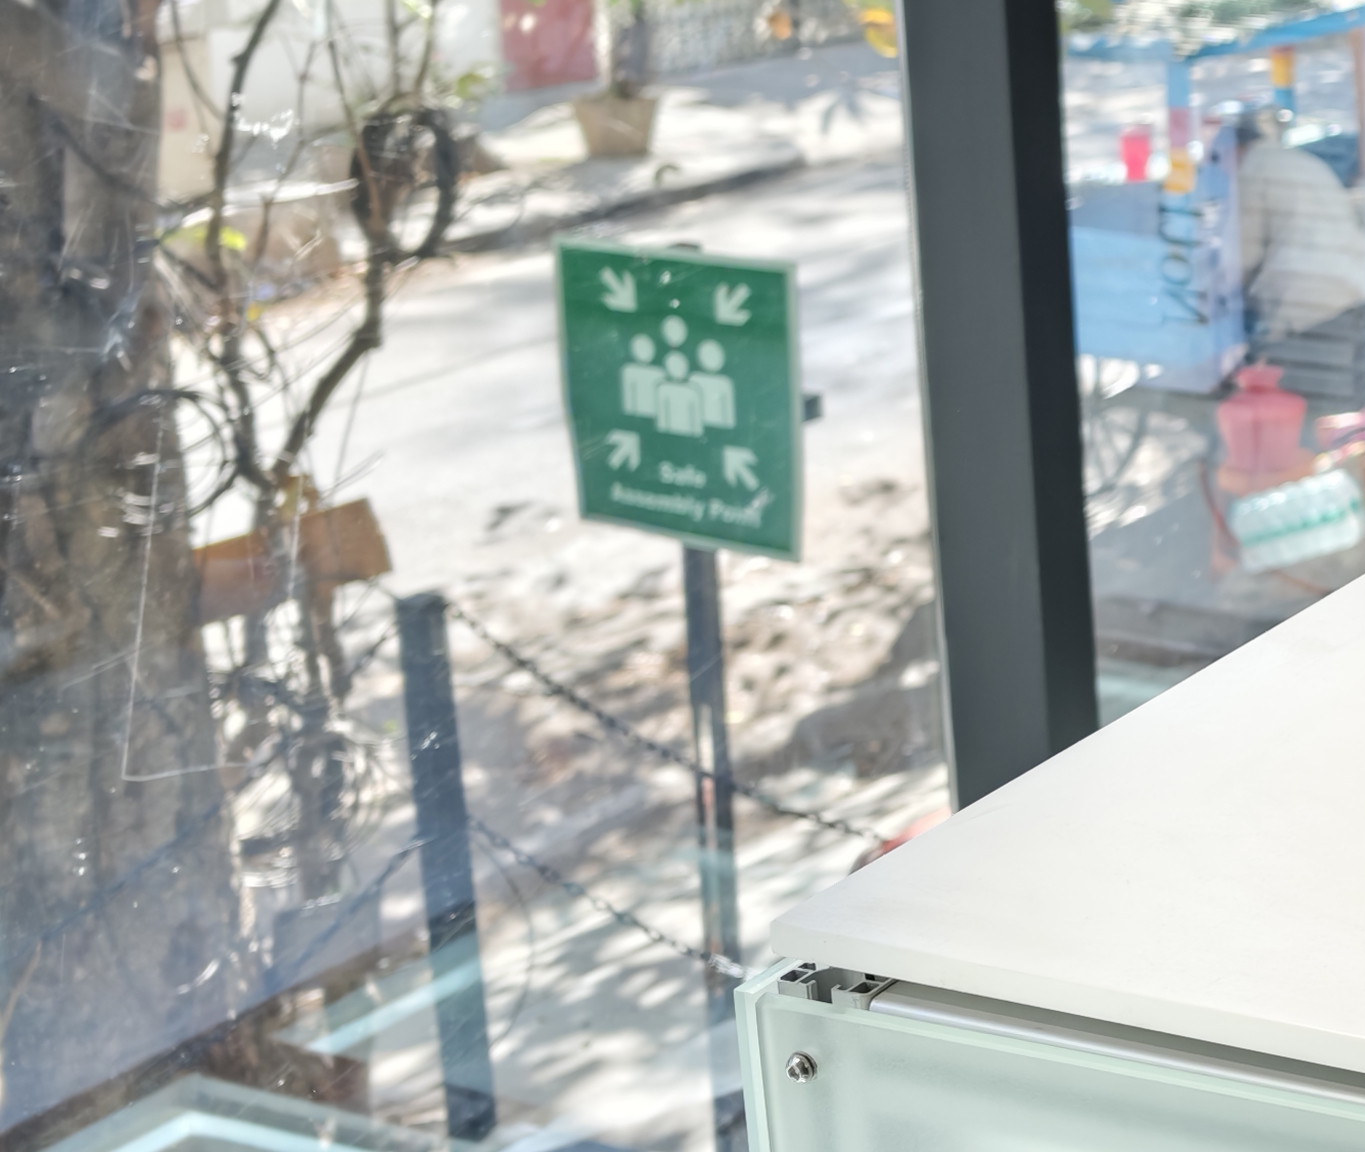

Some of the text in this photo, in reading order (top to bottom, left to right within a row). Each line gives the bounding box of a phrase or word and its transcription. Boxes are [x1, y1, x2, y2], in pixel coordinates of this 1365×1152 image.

[659, 460, 707, 488] Safe
[610, 481, 762, 529] Assembly Point
